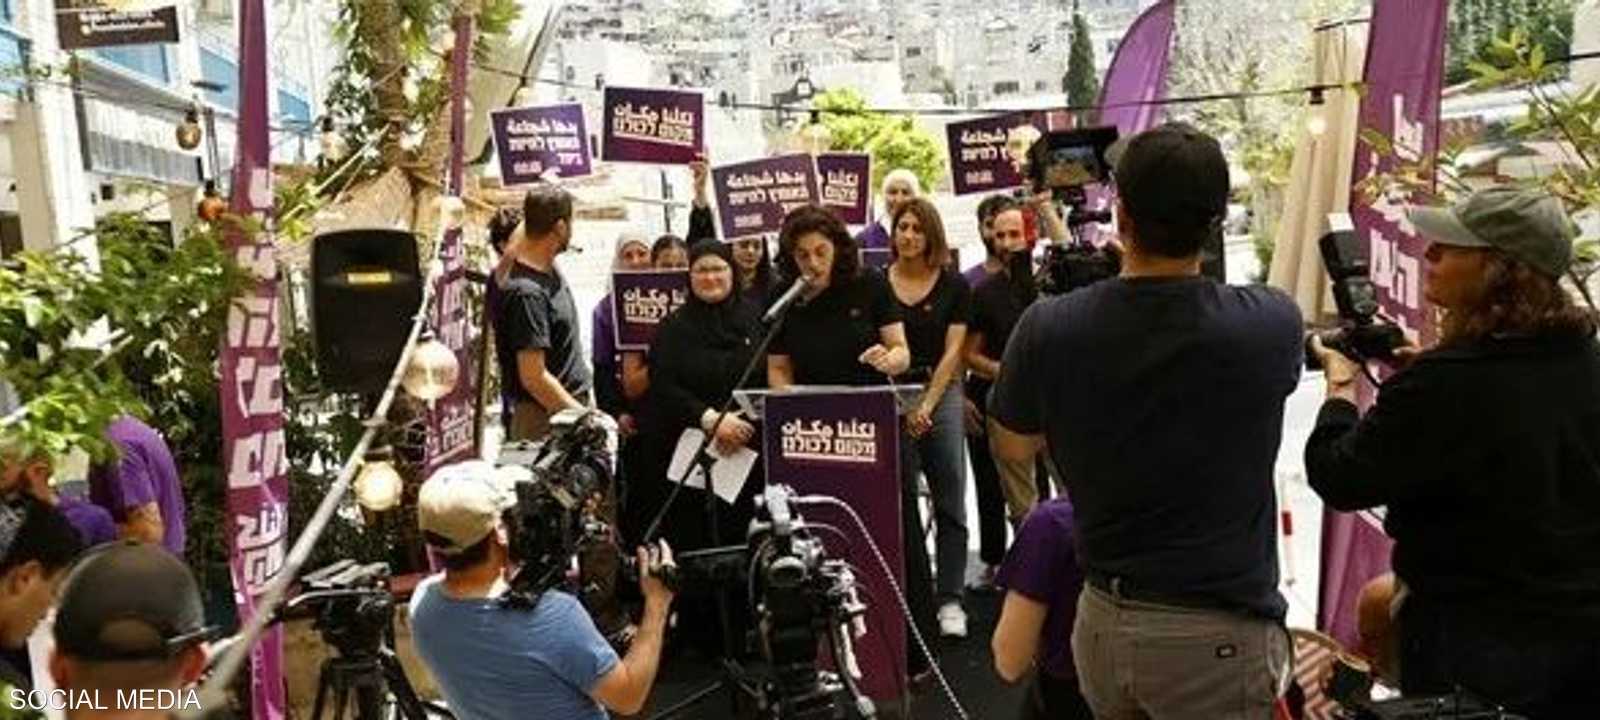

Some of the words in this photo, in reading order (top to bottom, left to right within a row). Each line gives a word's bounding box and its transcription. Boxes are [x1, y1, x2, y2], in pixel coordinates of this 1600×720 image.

[613, 117, 657, 137] לכולנו
[659, 122, 694, 143] מקום
[624, 301, 668, 318] לכולנו
[781, 418, 834, 438] مكان
[781, 435, 832, 453] לכולנו
[834, 438, 876, 457] מקום
